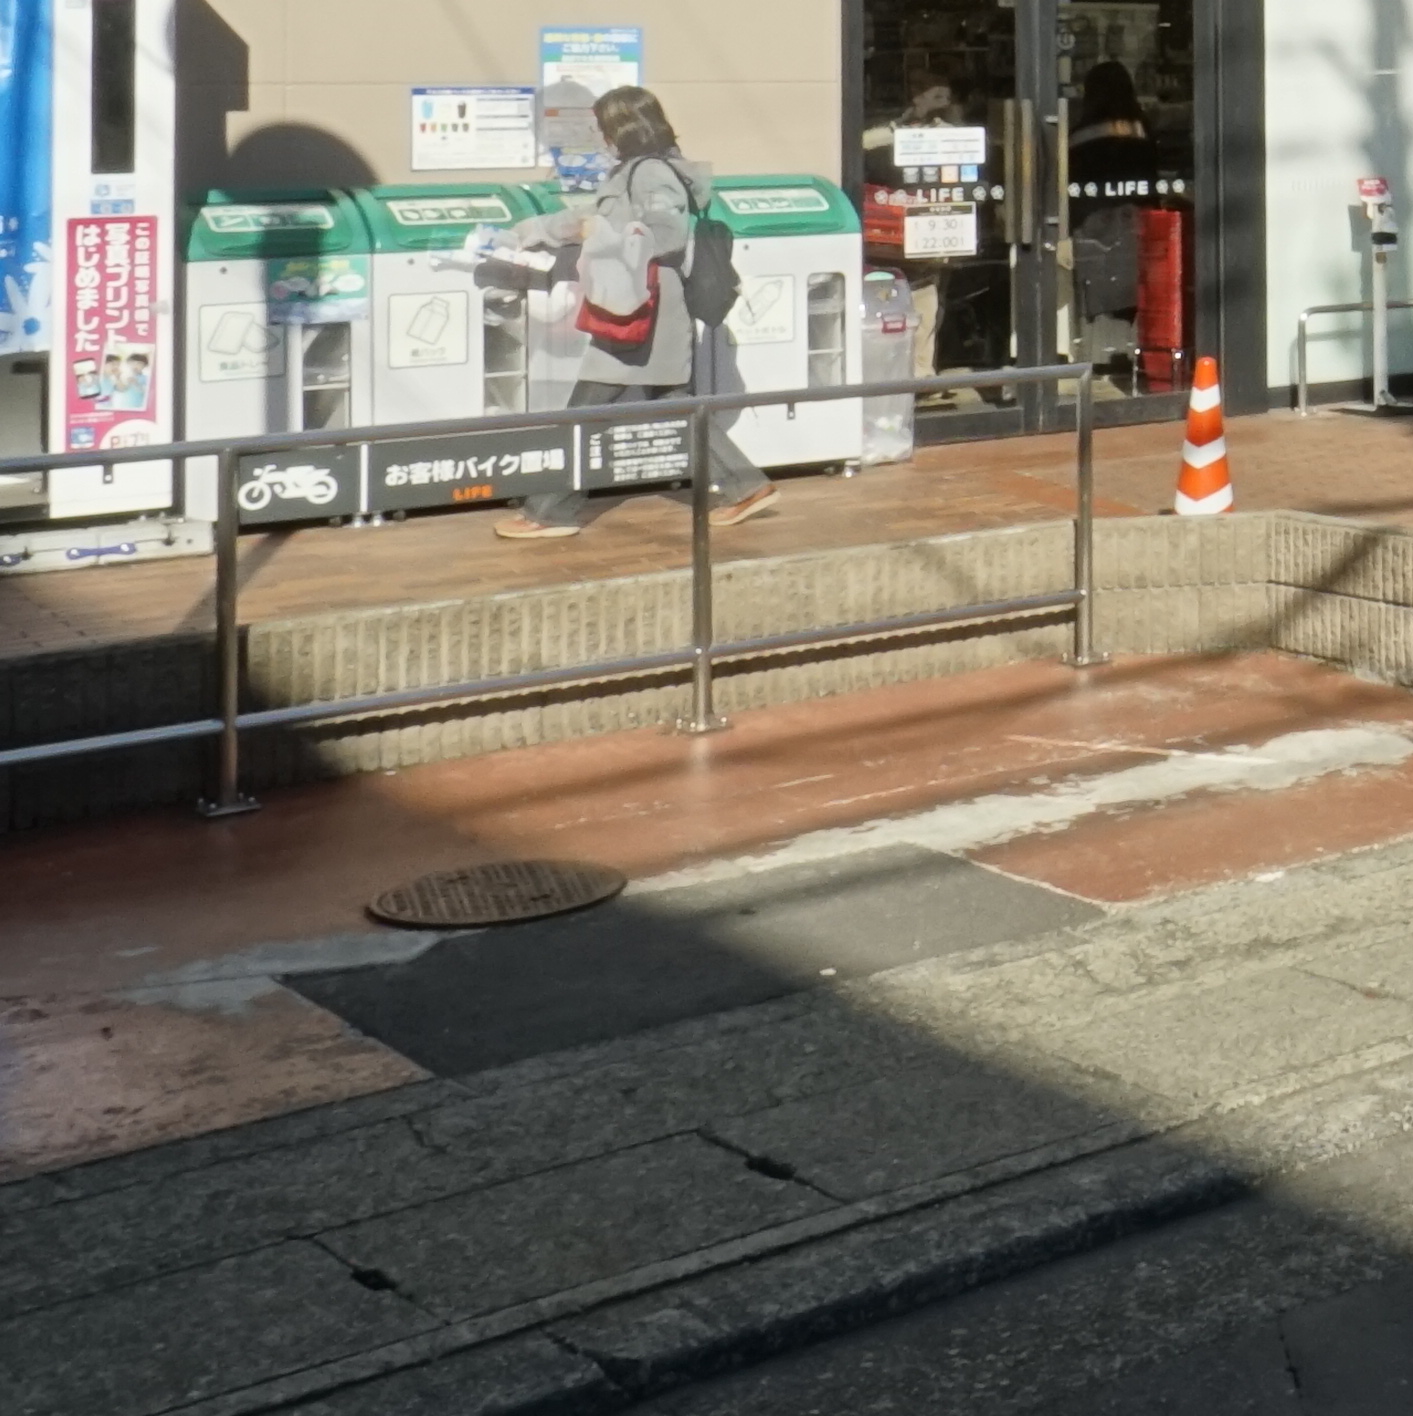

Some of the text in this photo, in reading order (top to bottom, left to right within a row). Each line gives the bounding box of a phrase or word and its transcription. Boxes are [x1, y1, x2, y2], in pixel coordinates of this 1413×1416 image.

[916, 187, 964, 204] LIFE
[1104, 180, 1150, 197] LIFE
[74, 224, 101, 353] はじめました
[104, 222, 131, 342] 写真プリント
[385, 447, 565, 487] お客様バイク置場
